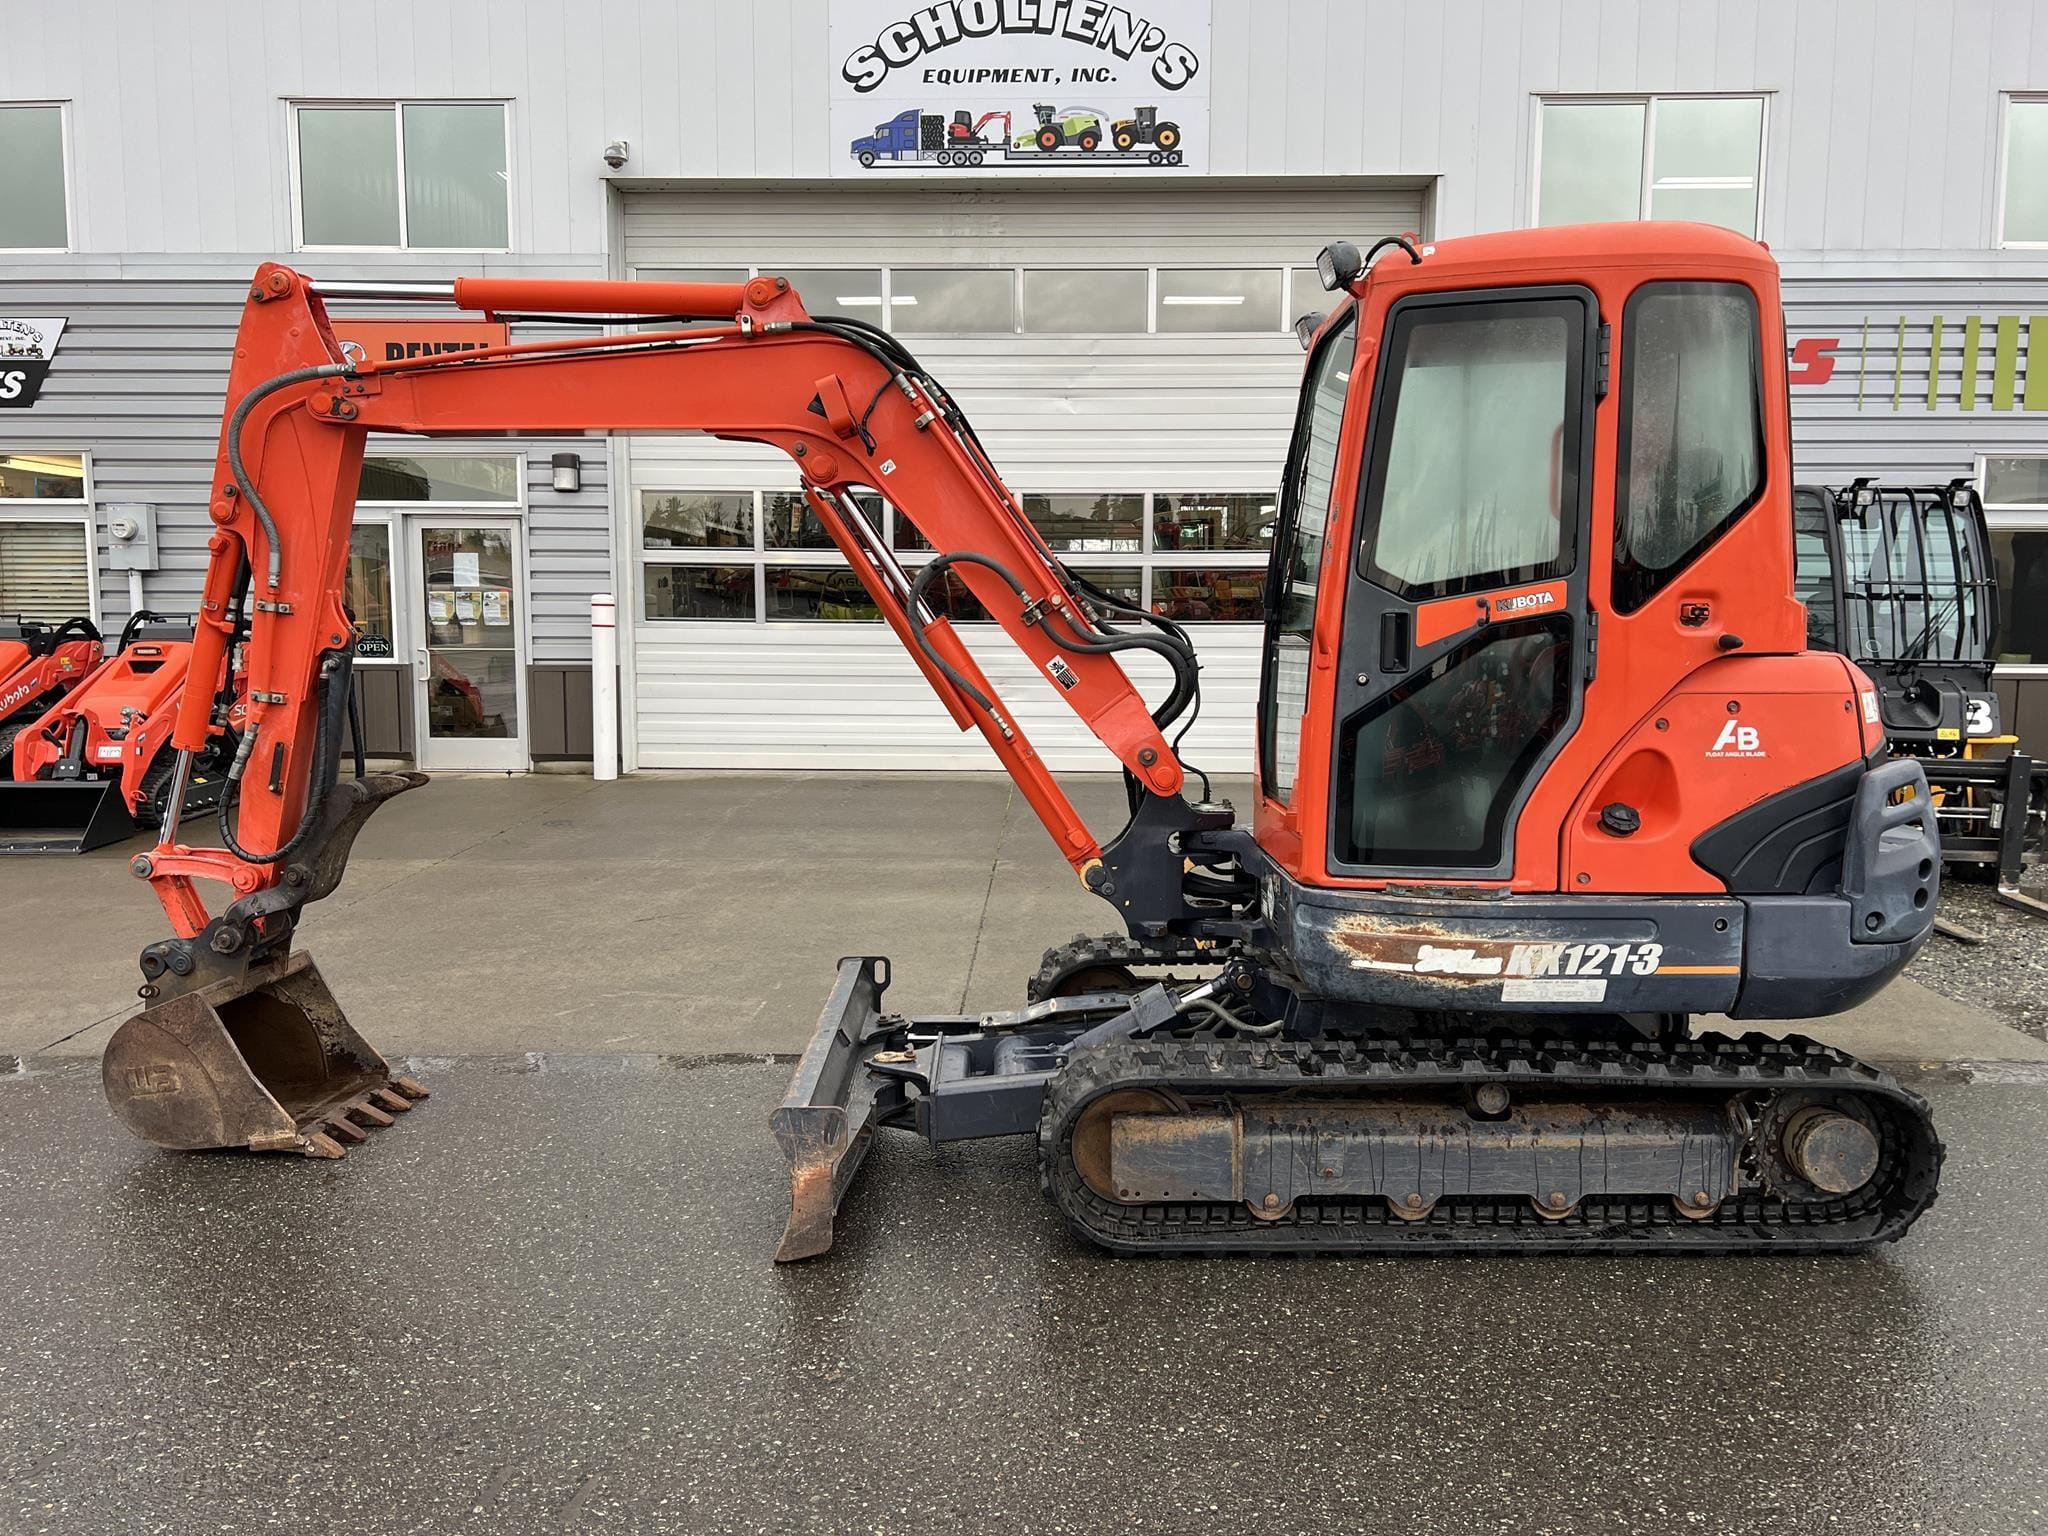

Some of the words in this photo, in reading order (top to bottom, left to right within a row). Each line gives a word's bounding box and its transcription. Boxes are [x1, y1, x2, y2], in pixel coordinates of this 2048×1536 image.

[842, 0, 1199, 93] SCHOLTEN'S
[922, 68, 1061, 86] EQUIPMENT,
[1071, 67, 1118, 83] INC.
[385, 342, 489, 360] RENT
[0, 371, 26, 399] S
[1496, 592, 1554, 612] KUBOTA
[357, 643, 389, 652] OPEN
[1504, 943, 1664, 976] KX121-3
